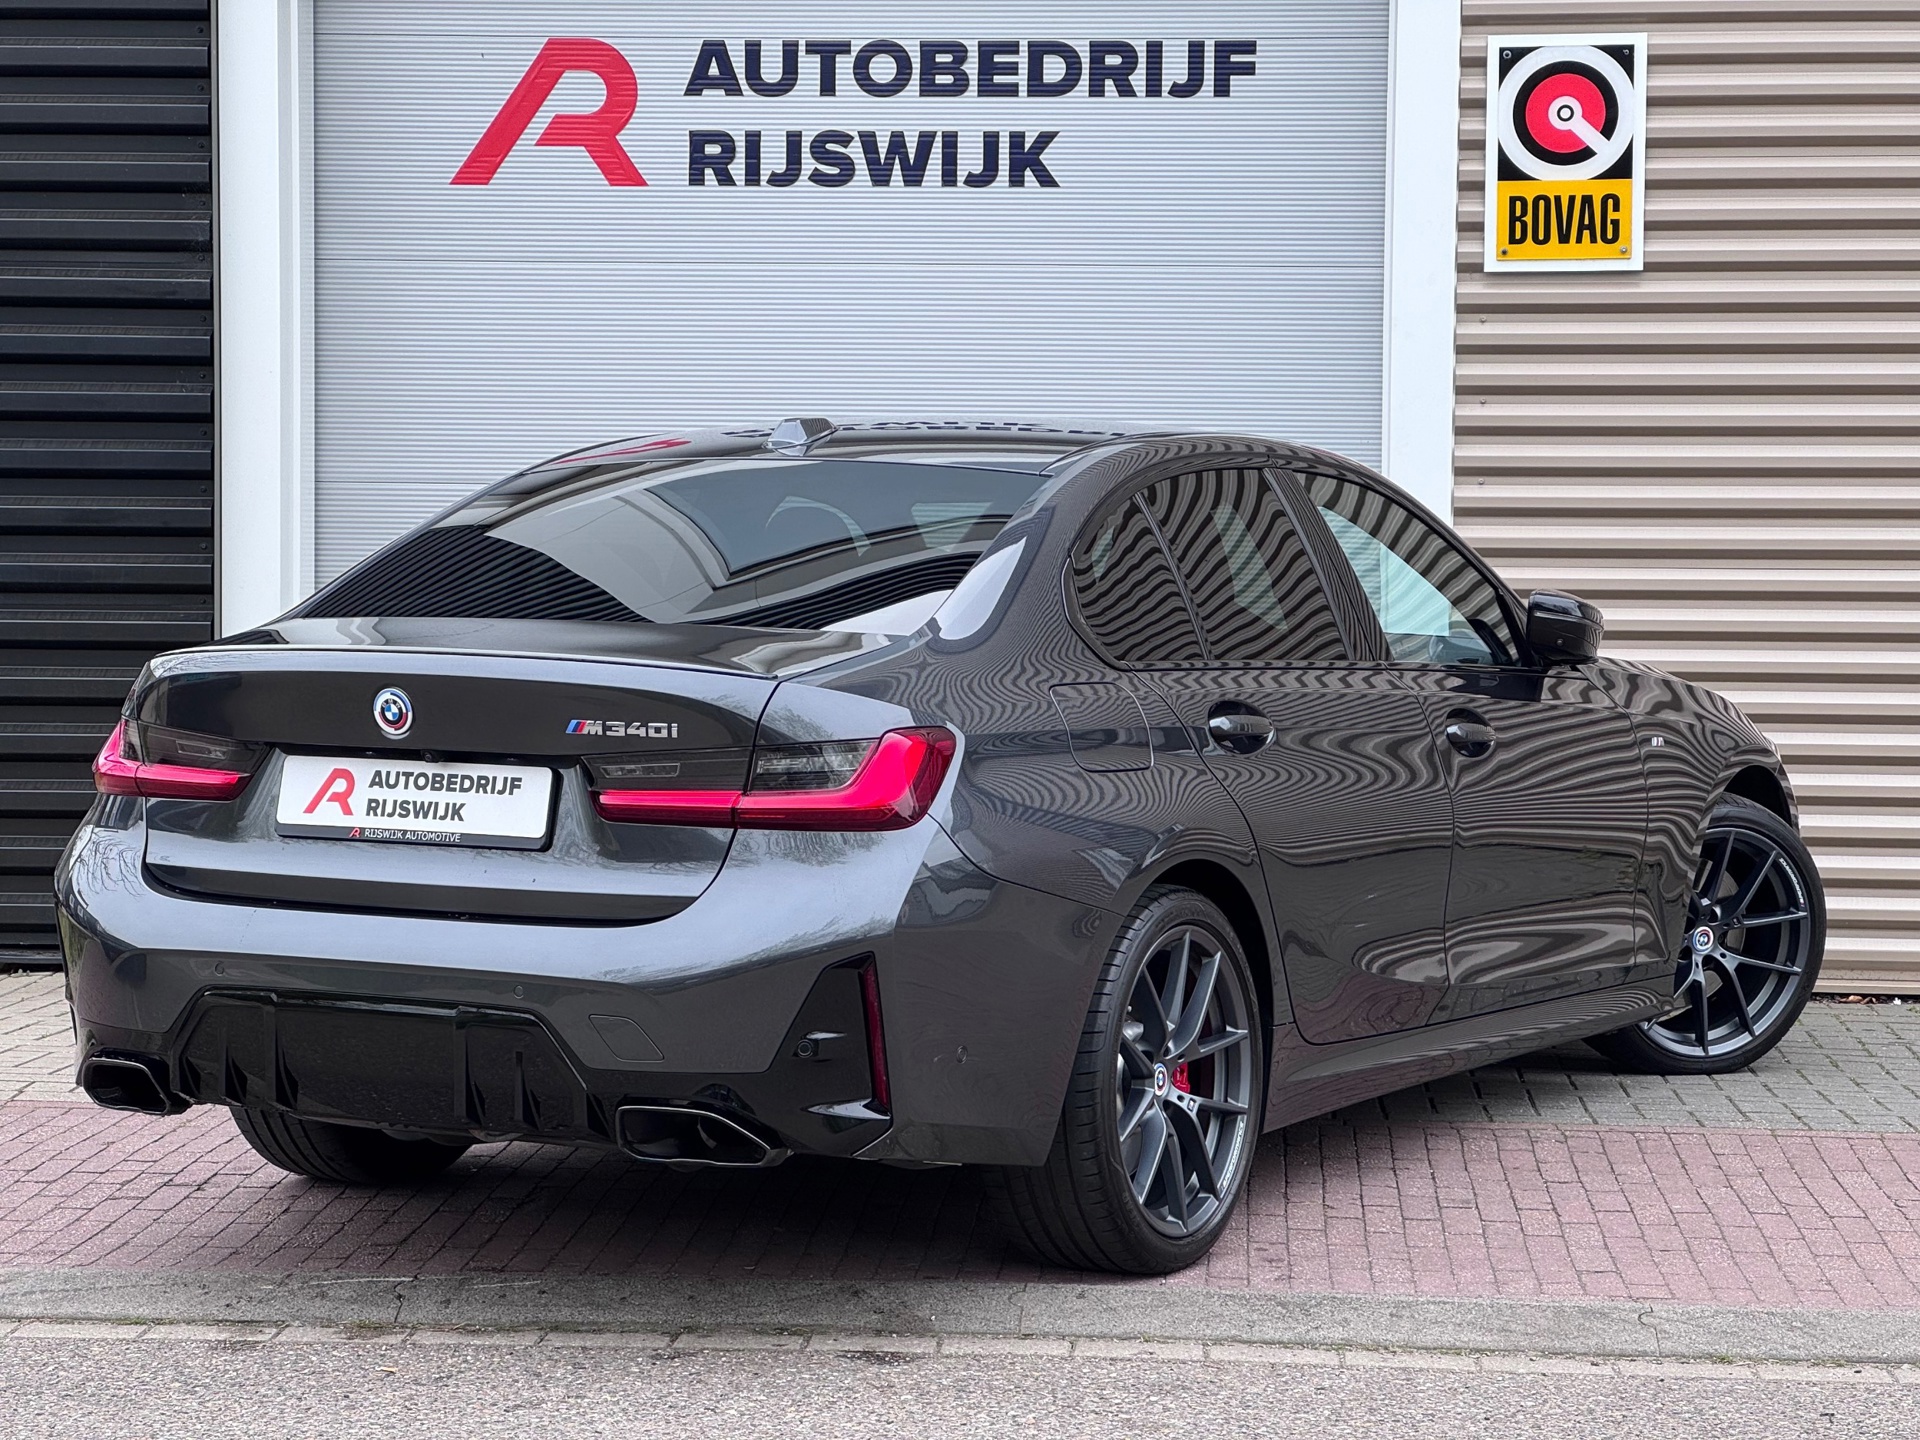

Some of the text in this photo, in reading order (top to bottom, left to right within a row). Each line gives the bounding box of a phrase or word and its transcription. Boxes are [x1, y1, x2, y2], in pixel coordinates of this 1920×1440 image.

[684, 39, 1257, 98] AUTOBEDRIJF
[688, 129, 1061, 188] RIJSWIJK
[1508, 193, 1621, 246] BOVAG
[567, 719, 678, 738] M340i
[368, 770, 523, 796] AUTOBEDRIJF
[366, 798, 466, 822] RIJSWIJK
[364, 828, 404, 840] RIJSWIJK
[405, 831, 461, 843] AUTOMOTIVE
